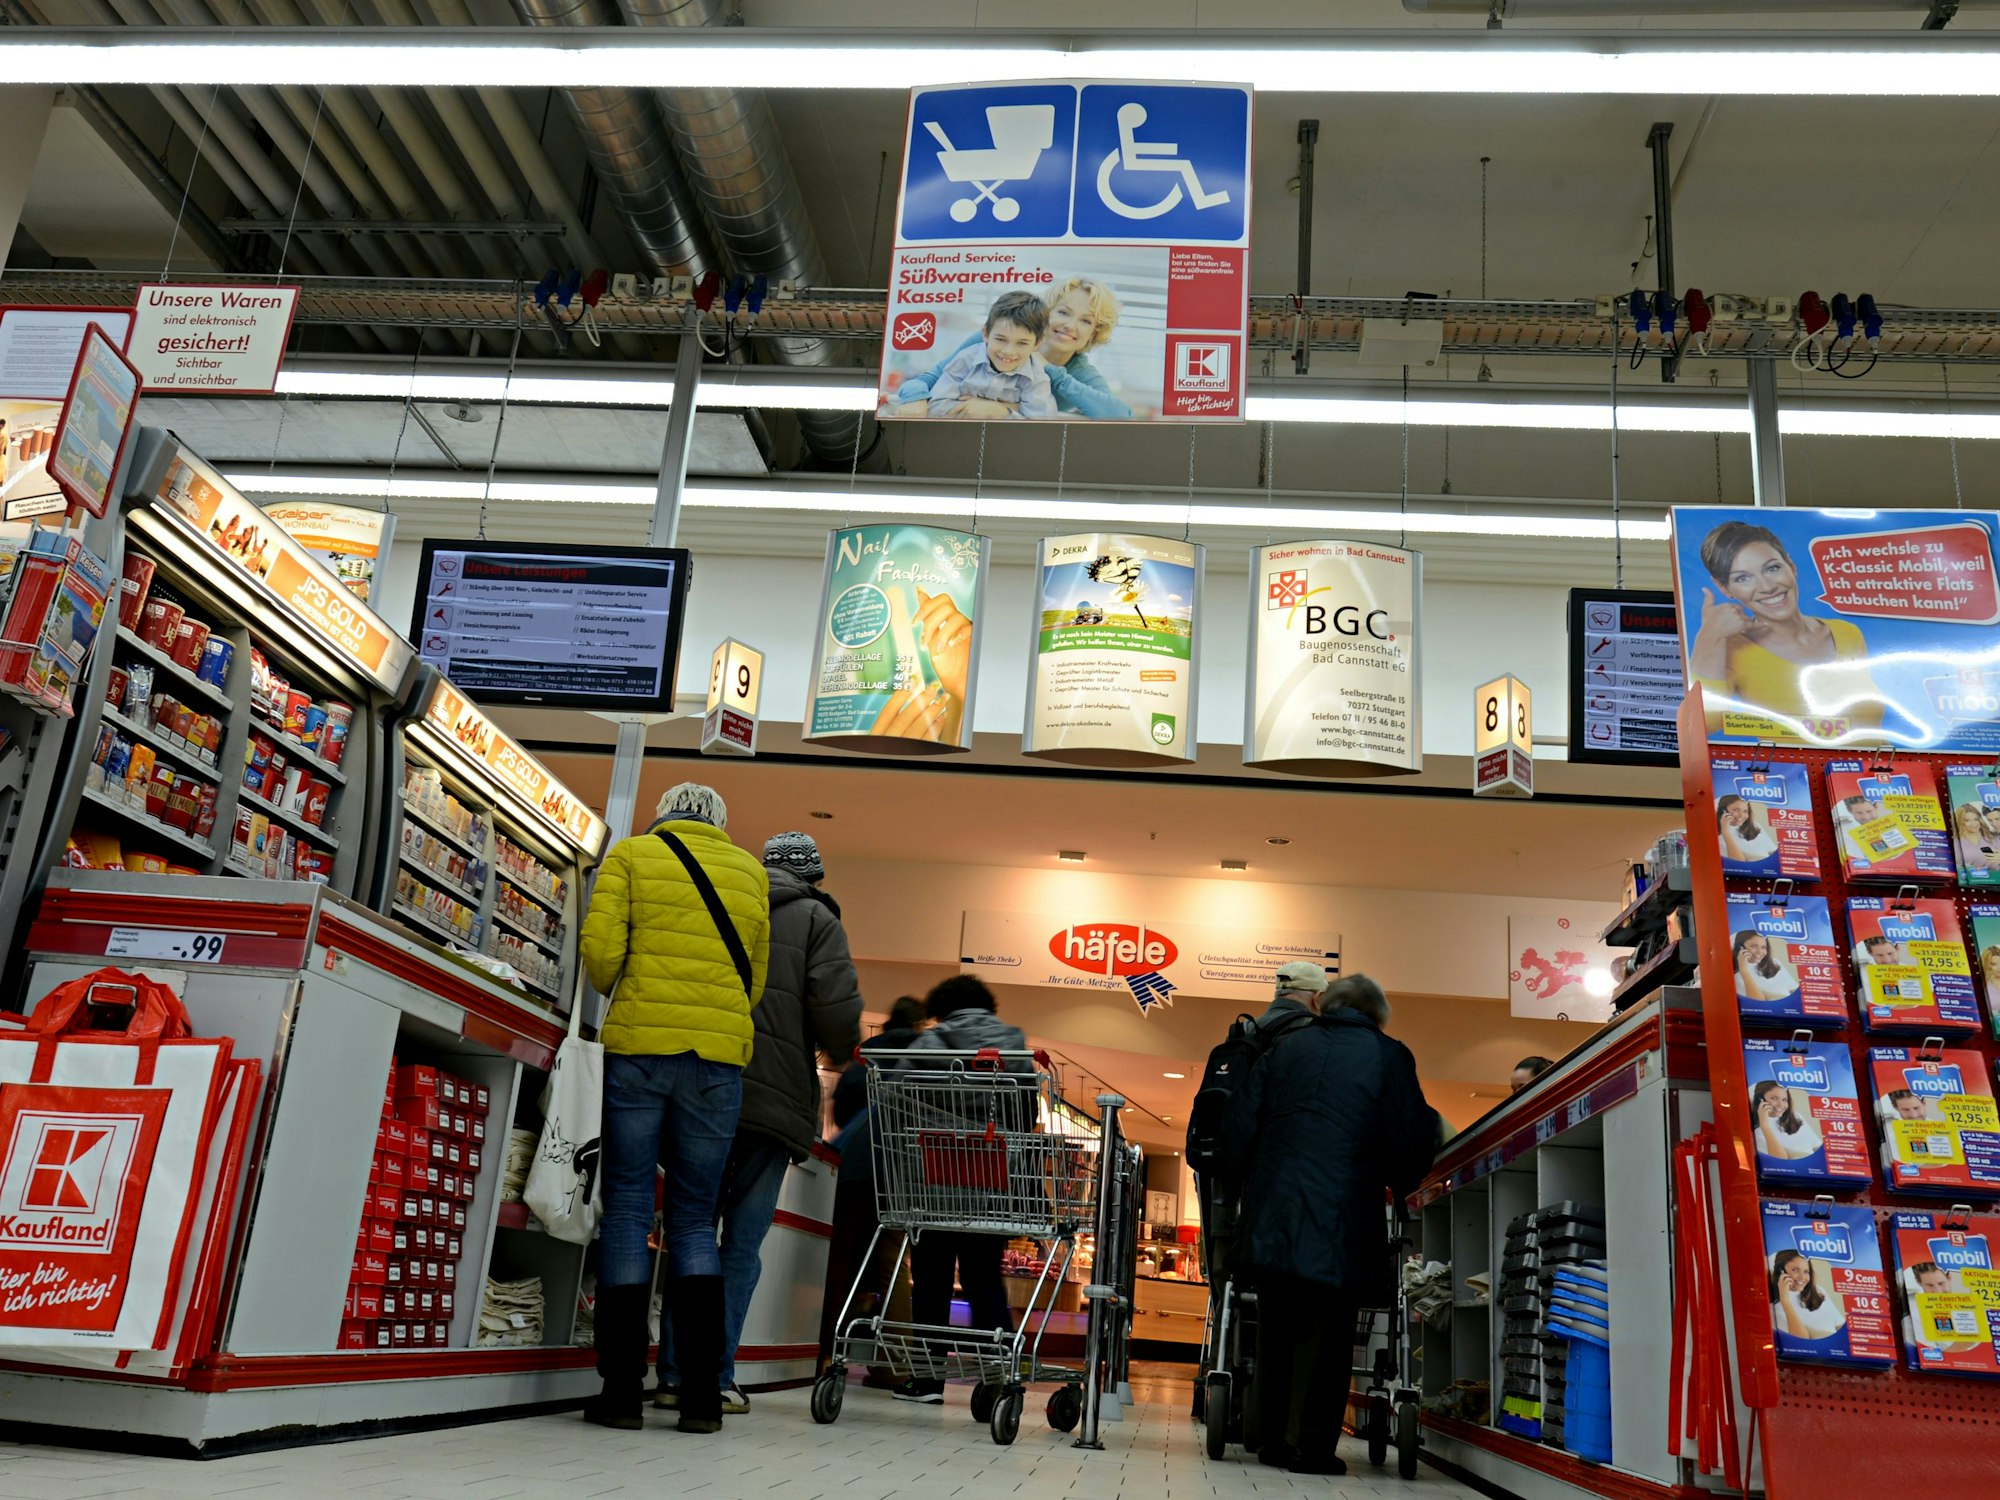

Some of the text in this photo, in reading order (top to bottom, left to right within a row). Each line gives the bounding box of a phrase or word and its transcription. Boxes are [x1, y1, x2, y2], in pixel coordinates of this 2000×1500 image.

[901, 252, 1015, 264] Kaufland Service:
[899, 267, 1053, 284] Süßwarenfreie
[150, 291, 282, 308] Unsere Waren
[897, 288, 963, 304] Kasse!
[163, 314, 257, 326] sind elektronisch
[157, 332, 250, 353] gesichert!
[176, 358, 222, 368] Sichtbar
[153, 373, 237, 385] und unsichtbar
[1178, 379, 1225, 387] Kaufland
[1177, 397, 1196, 406] Hier
[1188, 398, 1234, 412] ich richtig!
[15, 499, 44, 508] Rauchen
[285, 522, 329, 530] WOHNBAU
[836, 532, 890, 572] Nail
[1063, 546, 1088, 555] DEKRA
[1269, 547, 1405, 565] Sicher wohnen in Bad Cannstatt
[1822, 542, 1943, 560] „Ich wechsle zu
[80, 551, 103, 580] Reisen
[465, 561, 587, 579] Unsere Leistungen
[1824, 557, 1985, 573] K-Classic Mobil, weil
[877, 560, 947, 585] Fashion
[1829, 577, 1974, 591] ich attraktive Flats
[297, 576, 366, 640] JPS GOLD
[1834, 595, 1908, 608] zubuchen
[1623, 613, 1675, 627] Unsere
[856, 630, 876, 638] Rabatt
[1132, 633, 1154, 641] Himmel
[1300, 640, 1401, 658] Baugenossenschaft
[1630, 652, 1674, 660] Vorführwagen
[826, 653, 881, 663] NEUMODELLAGE
[1313, 654, 1405, 672] Bad Cannstatt eG
[737, 665, 750, 698] 9
[1340, 688, 1405, 704] Seelbergstraße 15
[1348, 701, 1405, 718] 70372 Stuttgart
[1486, 697, 1498, 731] 8
[723, 713, 752, 730] Bitte nicht
[1312, 713, 1339, 721] Telefon
[1379, 718, 1388, 726] 46
[1391, 719, 1405, 729] 81-0
[1518, 703, 1525, 738] 8
[728, 726, 744, 736] mehr
[1321, 727, 1405, 742] www.bgc-cannstatt.de
[1317, 739, 1405, 755] info@bgc-cannstatt.de
[498, 746, 541, 786] JPS GOLD
[1479, 753, 1506, 769] Bitte nicht
[1485, 766, 1500, 776] mehr
[1741, 787, 1782, 798] mobil
[1865, 786, 1908, 797] mobil
[1779, 810, 1787, 819] 9
[1787, 830, 1807, 839] 10 €
[1758, 921, 1802, 932] mobil
[1887, 925, 1930, 939] mobil
[173, 935, 222, 960] -.99
[1065, 923, 1166, 978] häfele
[1284, 946, 1322, 954] Schlachtung
[1799, 945, 1807, 955] 9
[977, 954, 1016, 964] Heiße Theke
[1204, 955, 1251, 964] Fleischqualität
[1922, 958, 1953, 968] 12,95
[1206, 970, 1244, 978] Wurstgenuss
[1807, 967, 1831, 976] 10 €
[1778, 1071, 1824, 1083] mobil
[1911, 1078, 1958, 1093] mobil
[1821, 1098, 1853, 1110] 9 Cent
[1949, 1113, 1983, 1124] 12,95
[1831, 1122, 1855, 1132] 10 €
[0, 1216, 110, 1241] Kaufland
[1801, 1239, 1847, 1253] mobil
[1937, 1251, 1985, 1266] mobil
[33, 1262, 68, 1285] bin
[1845, 1270, 1877, 1284] 9 Cent
[3, 1275, 117, 1312] ich richtig!
[1855, 1297, 1880, 1309] 10 €
